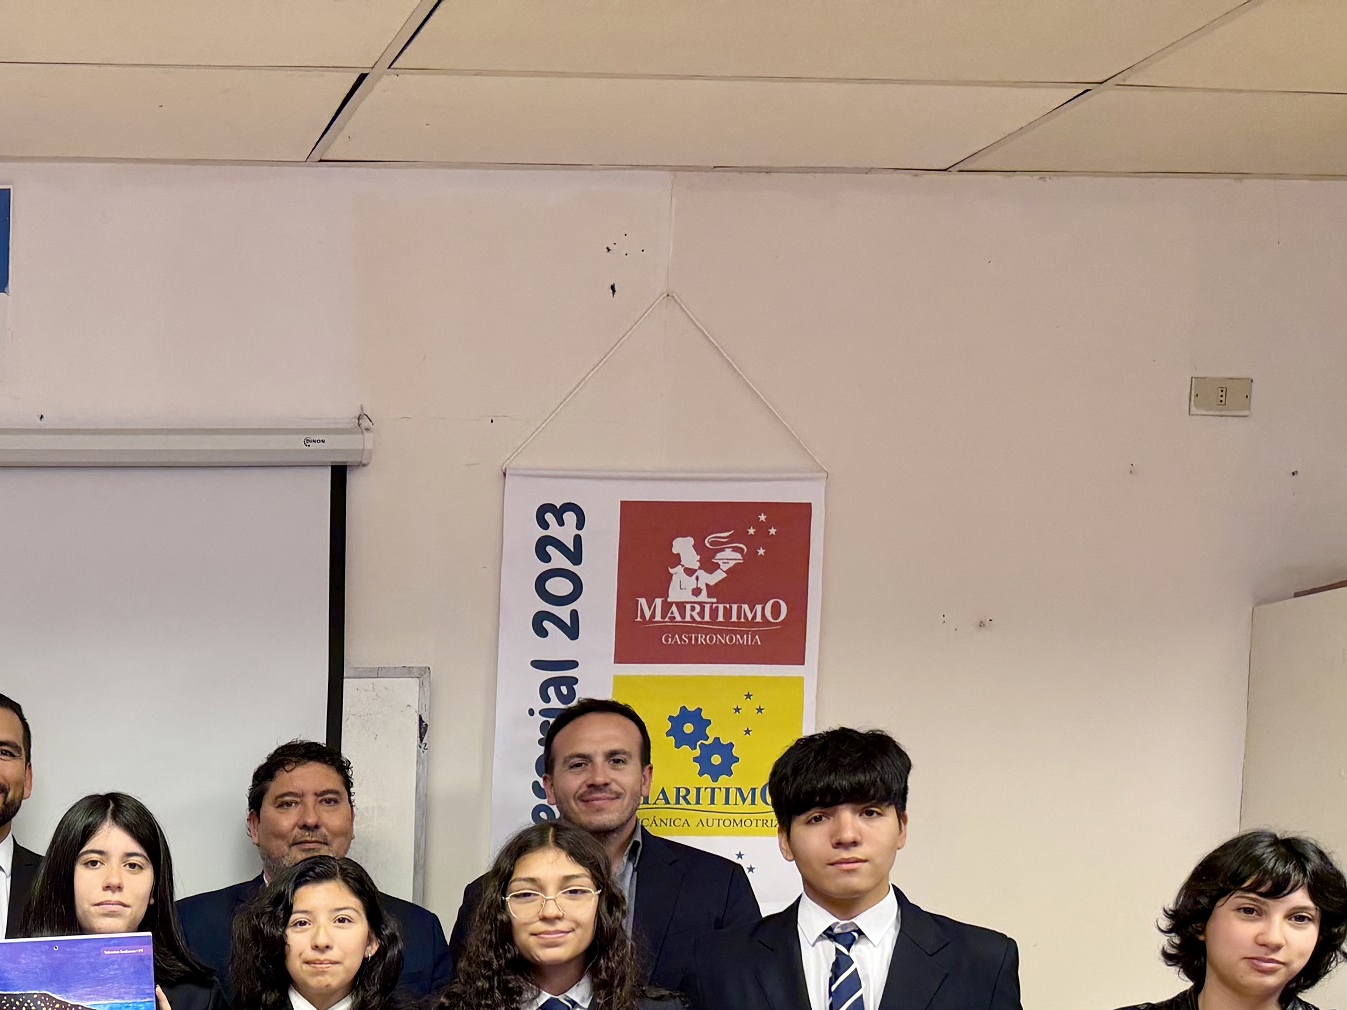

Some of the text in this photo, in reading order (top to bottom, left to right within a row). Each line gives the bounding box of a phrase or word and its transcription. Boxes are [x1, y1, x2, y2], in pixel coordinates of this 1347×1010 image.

[531, 502, 586, 641] 2023
[635, 598, 788, 623] MARITIMO
[662, 632, 761, 645] GASTRONOMÍA
[640, 816, 690, 828] CÁNICA
